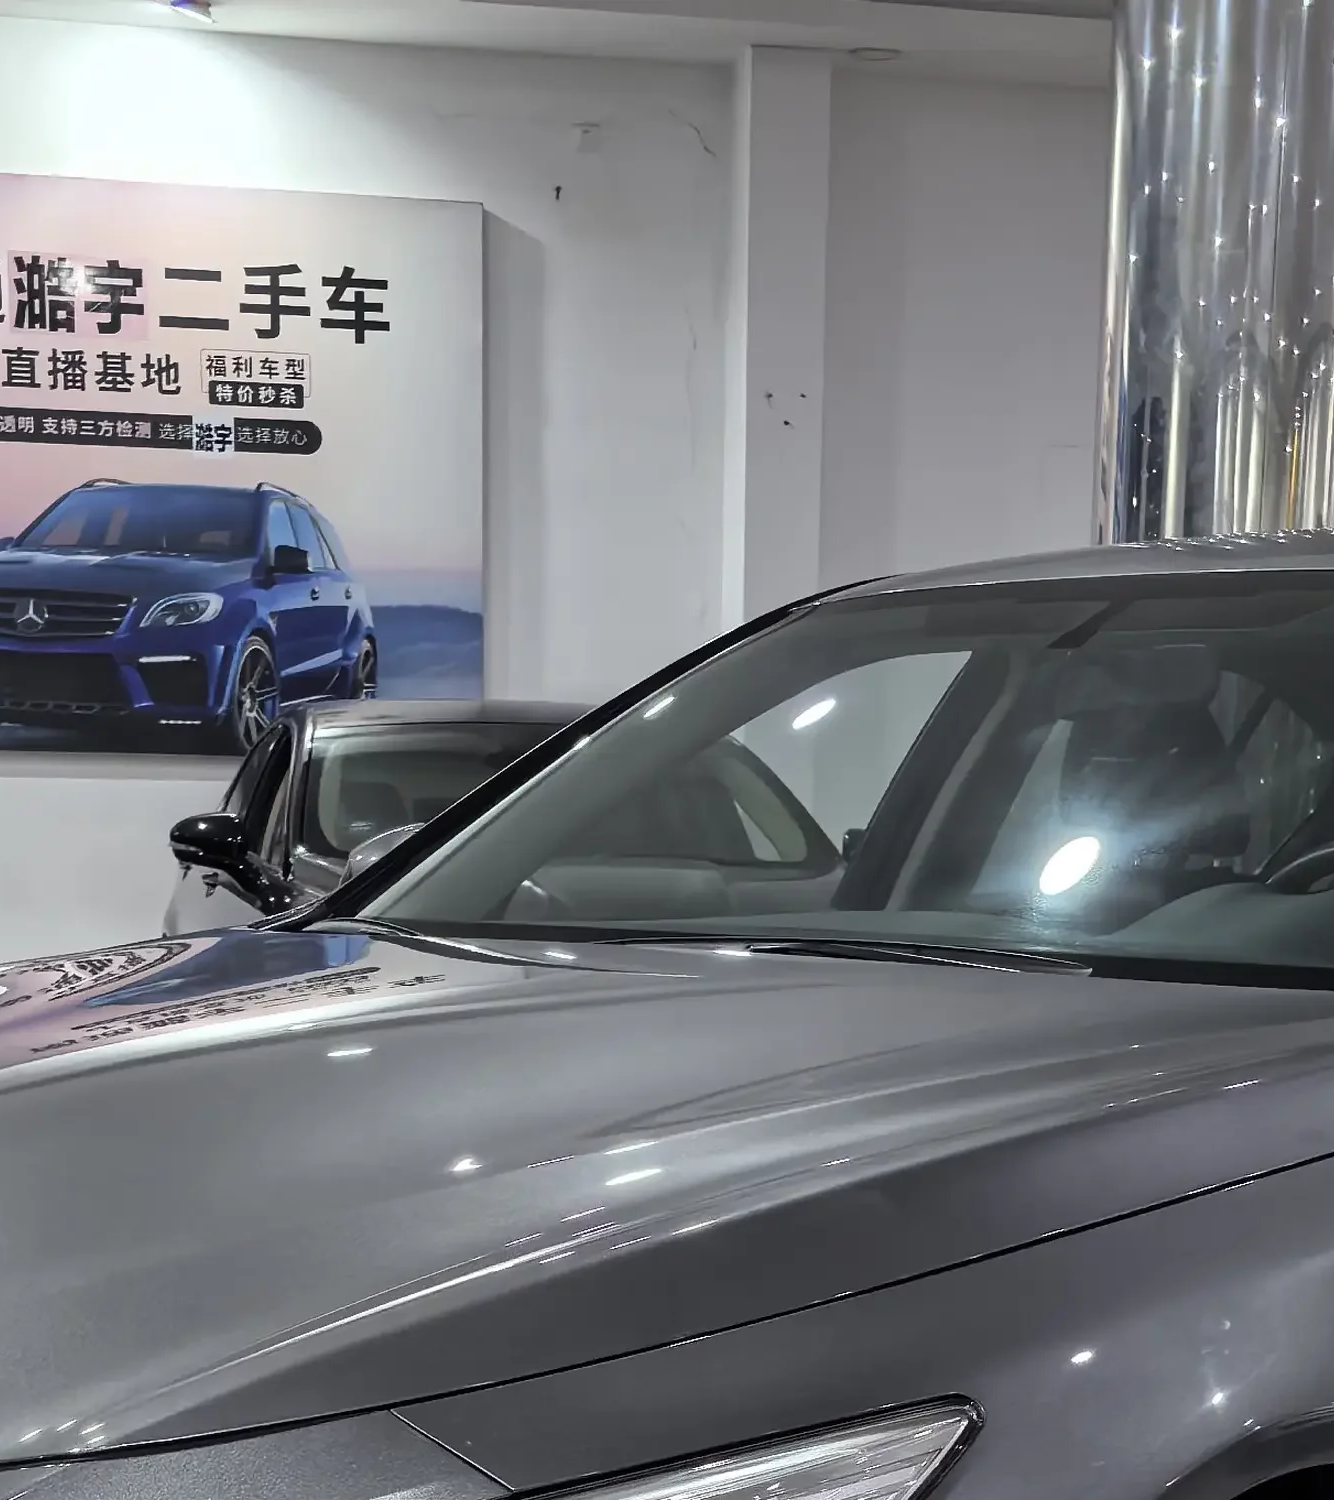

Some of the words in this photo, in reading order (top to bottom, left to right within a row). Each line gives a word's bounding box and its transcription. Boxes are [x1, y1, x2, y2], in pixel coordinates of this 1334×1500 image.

[1, 346, 182, 395] 直播基地
[205, 354, 307, 381] 福利车型
[214, 383, 299, 406] 特价秒杀
[41, 416, 152, 439] 支持三方检测
